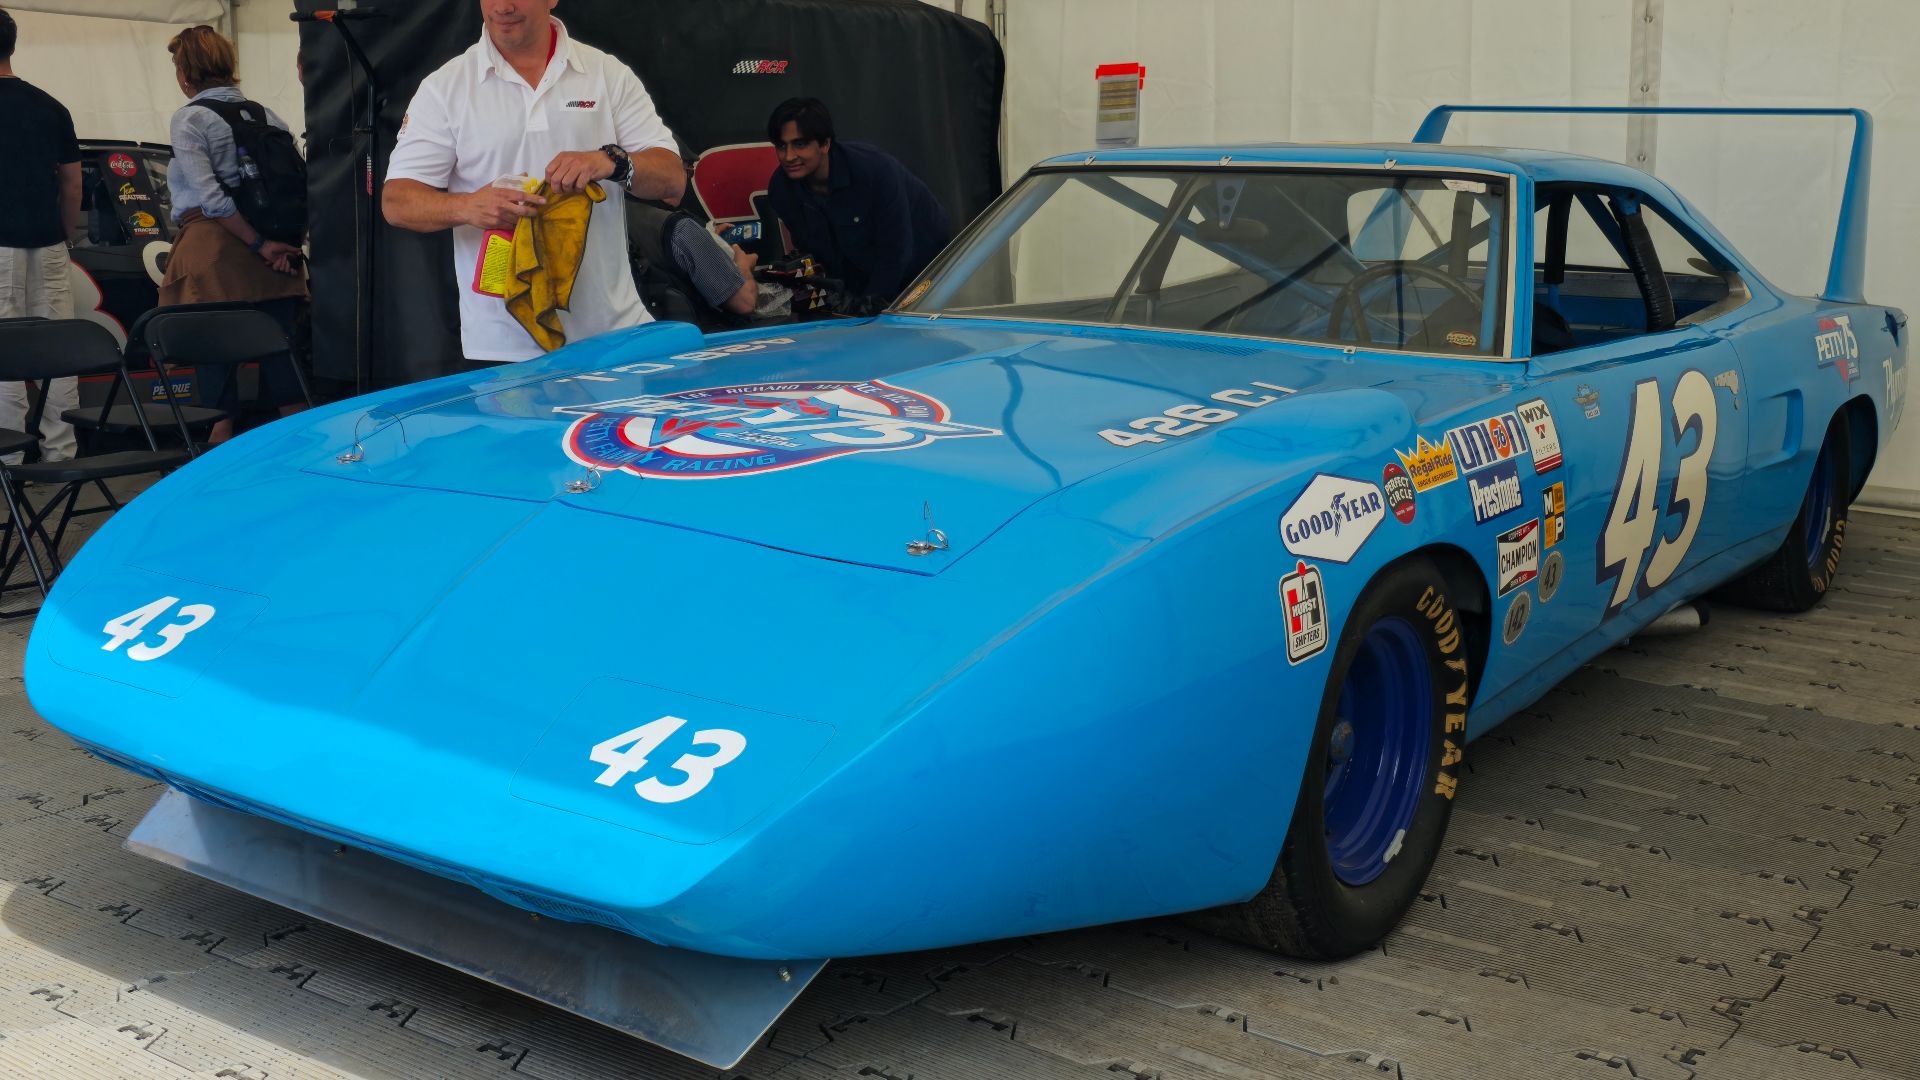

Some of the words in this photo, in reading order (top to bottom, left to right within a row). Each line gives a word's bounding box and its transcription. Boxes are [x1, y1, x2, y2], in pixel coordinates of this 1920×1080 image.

[1814, 331, 1845, 361] PETTY
[152, 382, 192, 396] PEDUE
[1096, 404, 1239, 448] 426
[1519, 403, 1550, 424] WIX
[661, 453, 777, 471] RACING
[1384, 476, 1410, 496] PERFECT
[1389, 488, 1413, 508] CIRCLE
[1469, 475, 1522, 522] Prestone
[1597, 368, 1718, 617] 43
[1501, 539, 1537, 575] CHAMPION
[1544, 563, 1557, 591] 43
[1291, 596, 1319, 619] HURST
[100, 595, 217, 662] 43
[1295, 627, 1320, 649] SHIFTERS
[589, 715, 748, 804] 43
